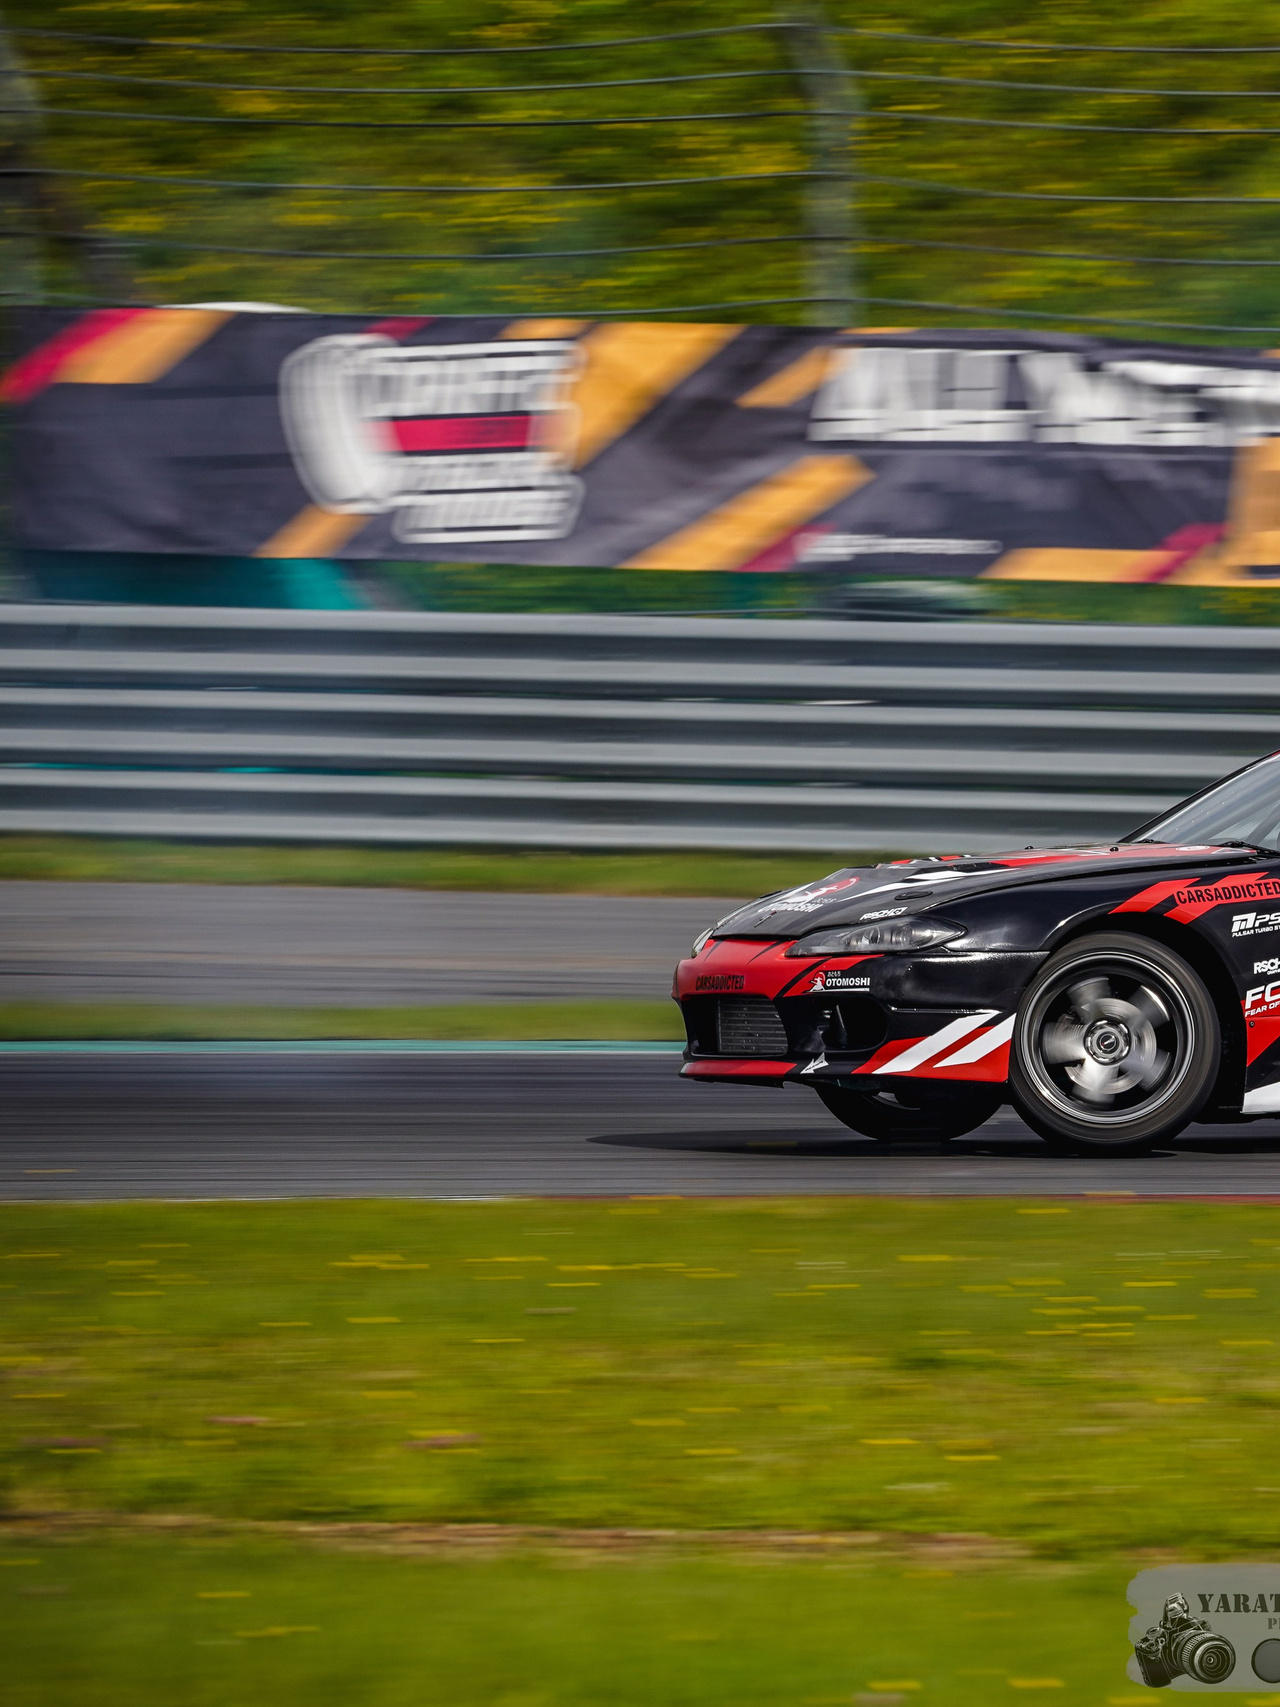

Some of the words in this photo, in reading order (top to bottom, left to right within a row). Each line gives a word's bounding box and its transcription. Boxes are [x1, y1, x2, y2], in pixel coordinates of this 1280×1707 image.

[1232, 928, 1254, 938] PULSAR
[1255, 925, 1274, 935] TURBO
[695, 975, 745, 991] CARSADDICTED
[826, 977, 871, 986] OTOMOSHI
[1245, 1004, 1268, 1017] FEAR
[1269, 1001, 1280, 1010] OF
